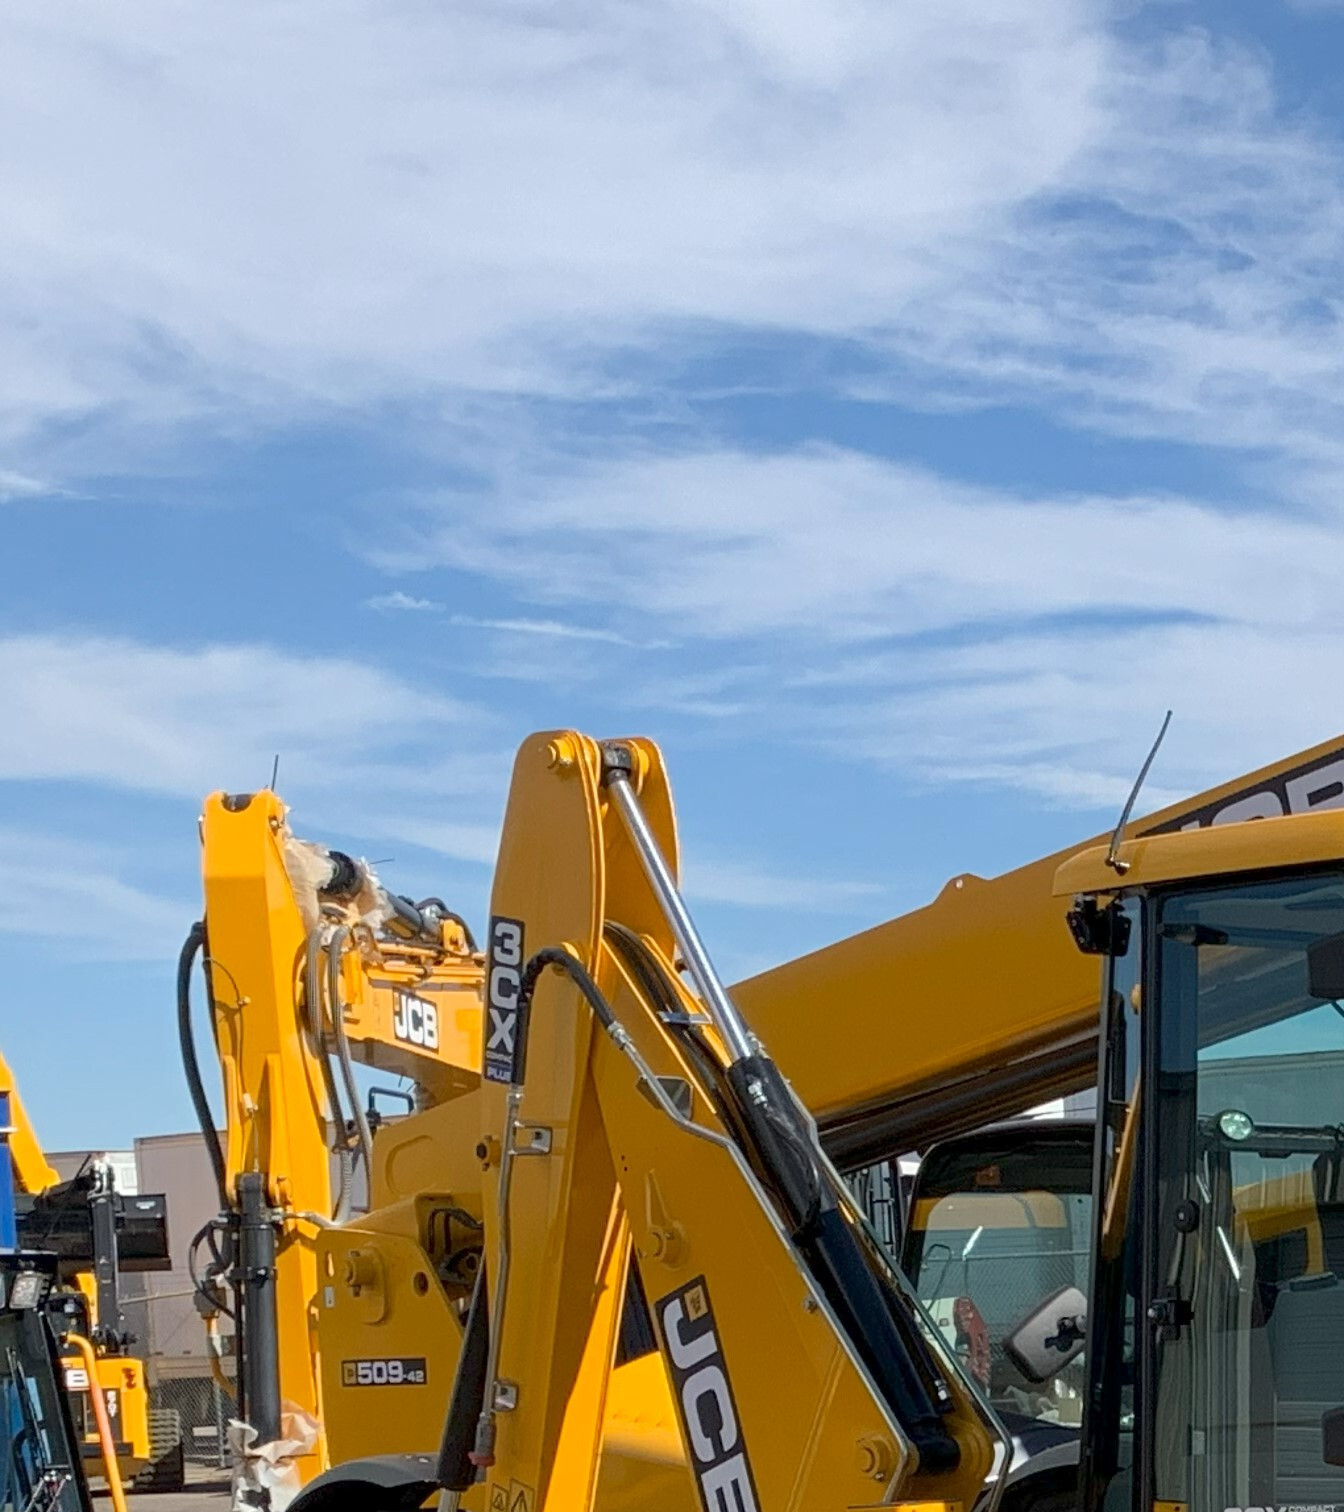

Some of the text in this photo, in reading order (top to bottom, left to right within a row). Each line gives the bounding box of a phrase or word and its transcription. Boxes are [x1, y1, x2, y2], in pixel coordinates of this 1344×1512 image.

[488, 921, 521, 1054] 3CX
[394, 992, 438, 1049] JCB
[357, 1360, 425, 1385] 509-42
